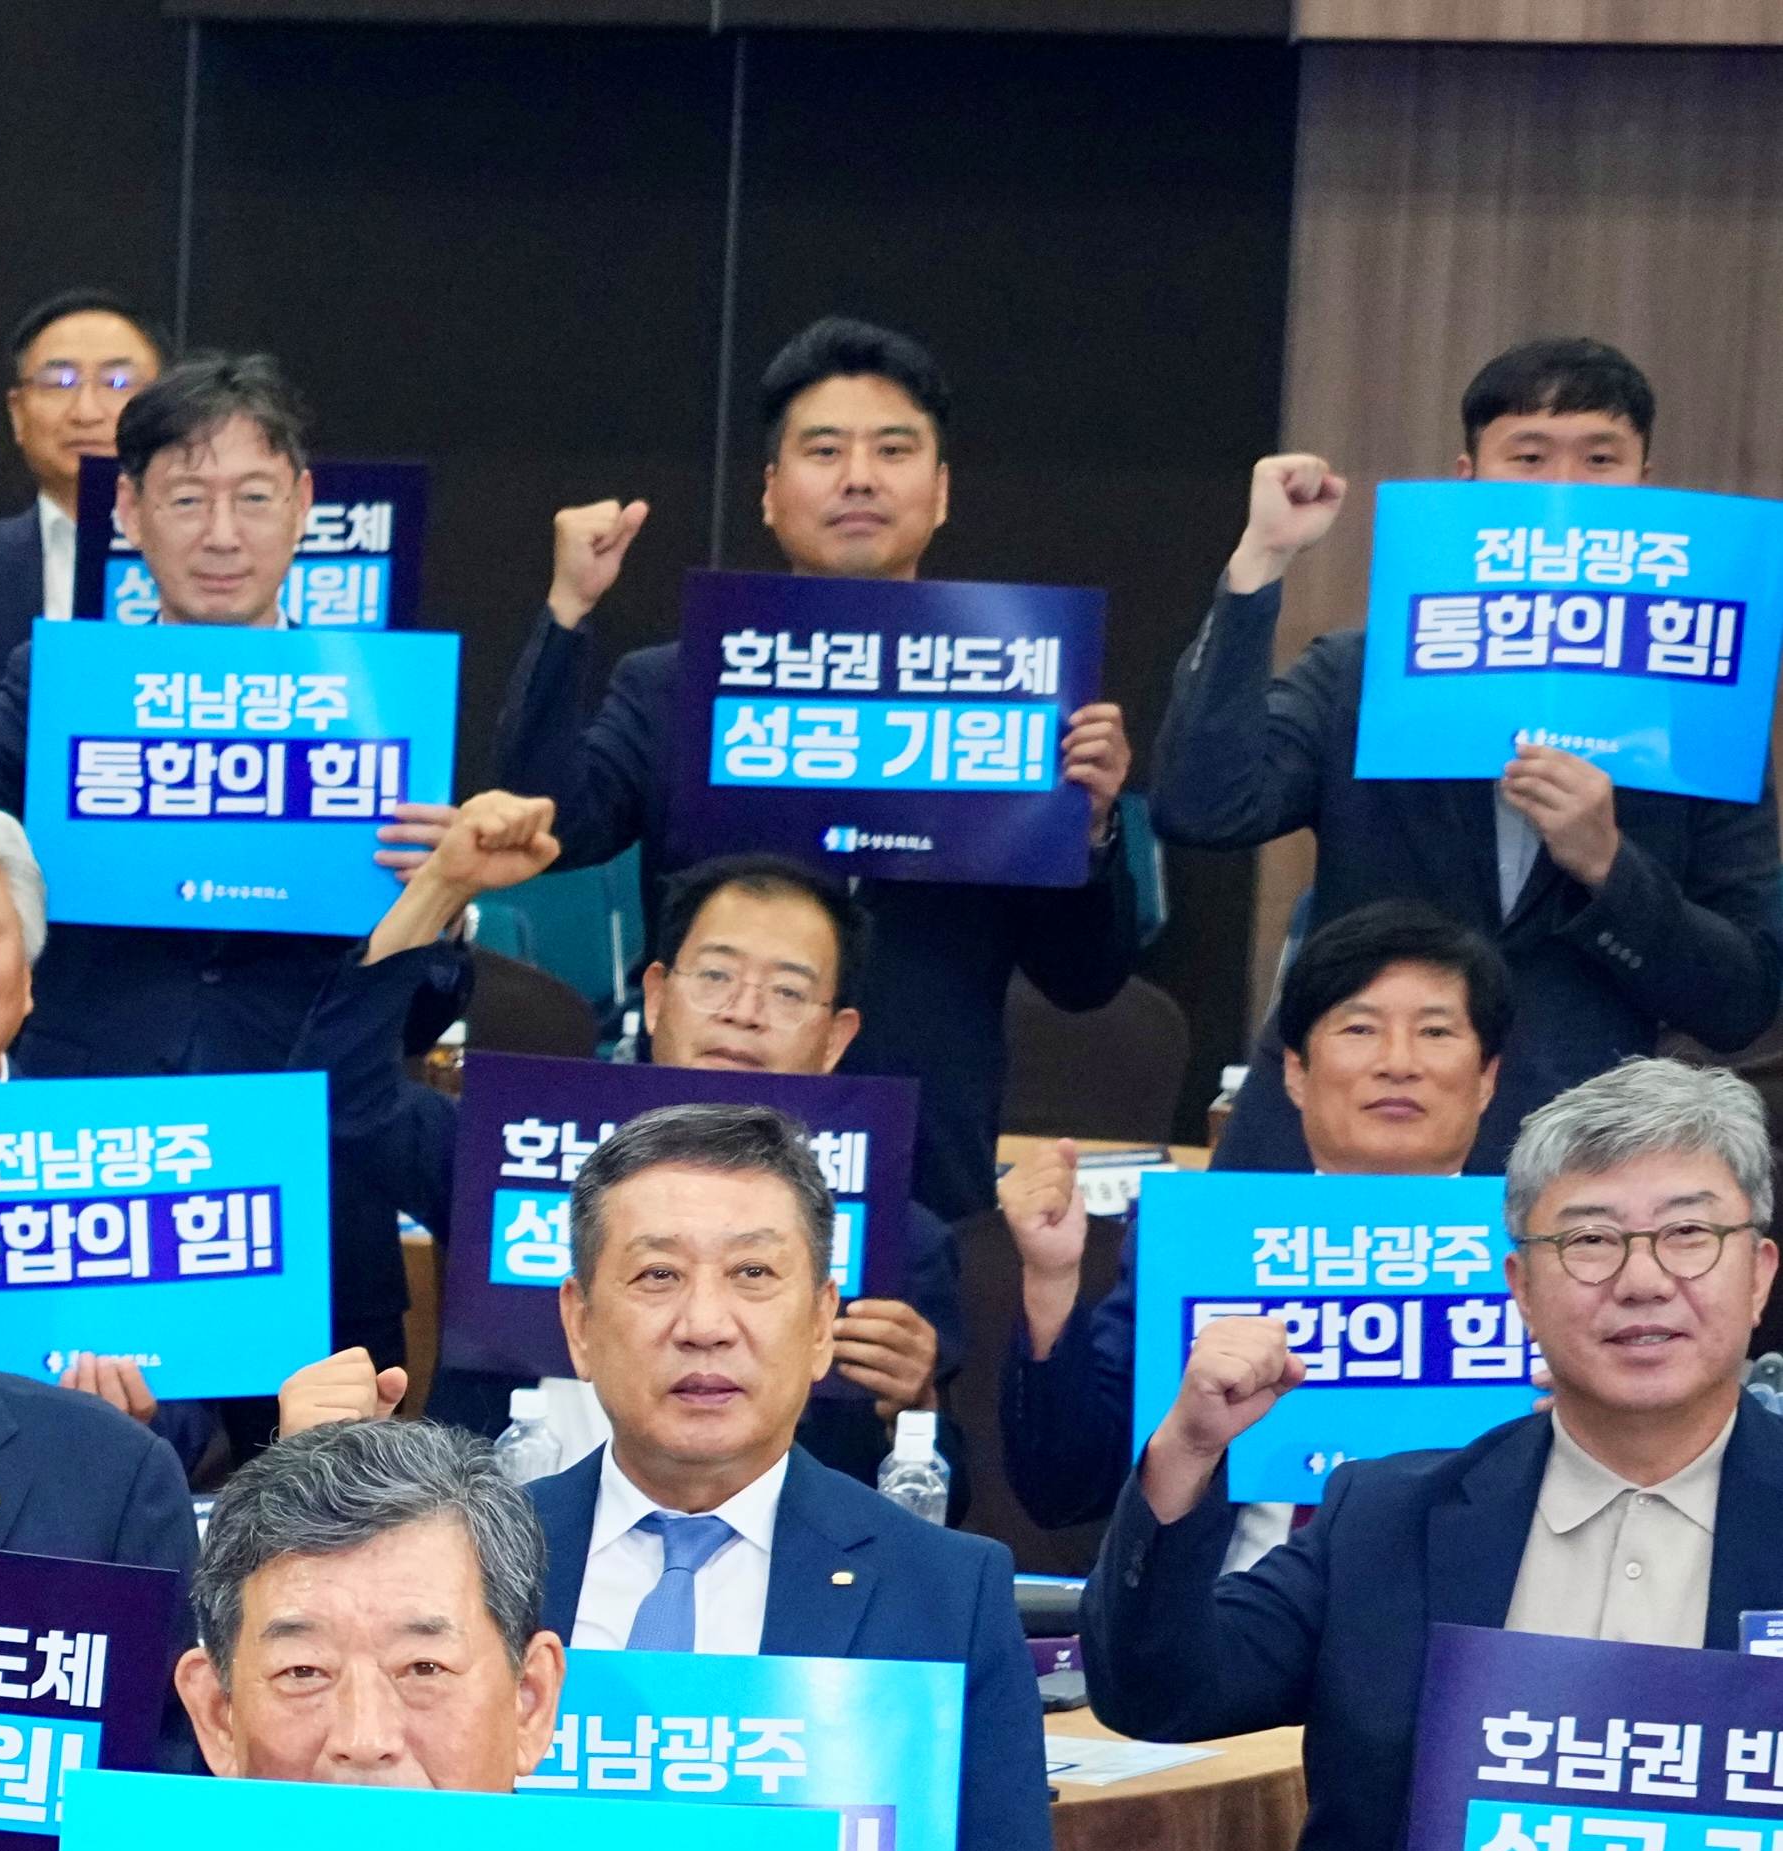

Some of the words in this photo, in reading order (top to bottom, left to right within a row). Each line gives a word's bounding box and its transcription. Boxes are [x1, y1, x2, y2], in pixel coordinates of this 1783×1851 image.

[304, 501, 392, 553] 도체
[1474, 527, 1690, 587] 전남광주
[720, 629, 880, 690] 호남권
[898, 634, 1061, 696] 반도체
[1414, 595, 1625, 671] 통합의
[1647, 600, 1737, 678] 힘!
[135, 673, 347, 733] 전남광주
[75, 740, 284, 816] 통합의
[307, 743, 399, 817] 힘!
[723, 705, 860, 780] 성공
[882, 709, 1048, 782] 기원!
[173, 1193, 274, 1276] 힘!
[1253, 1225, 1490, 1286] 전남광주
[1478, 1710, 1702, 1799] 호남권
